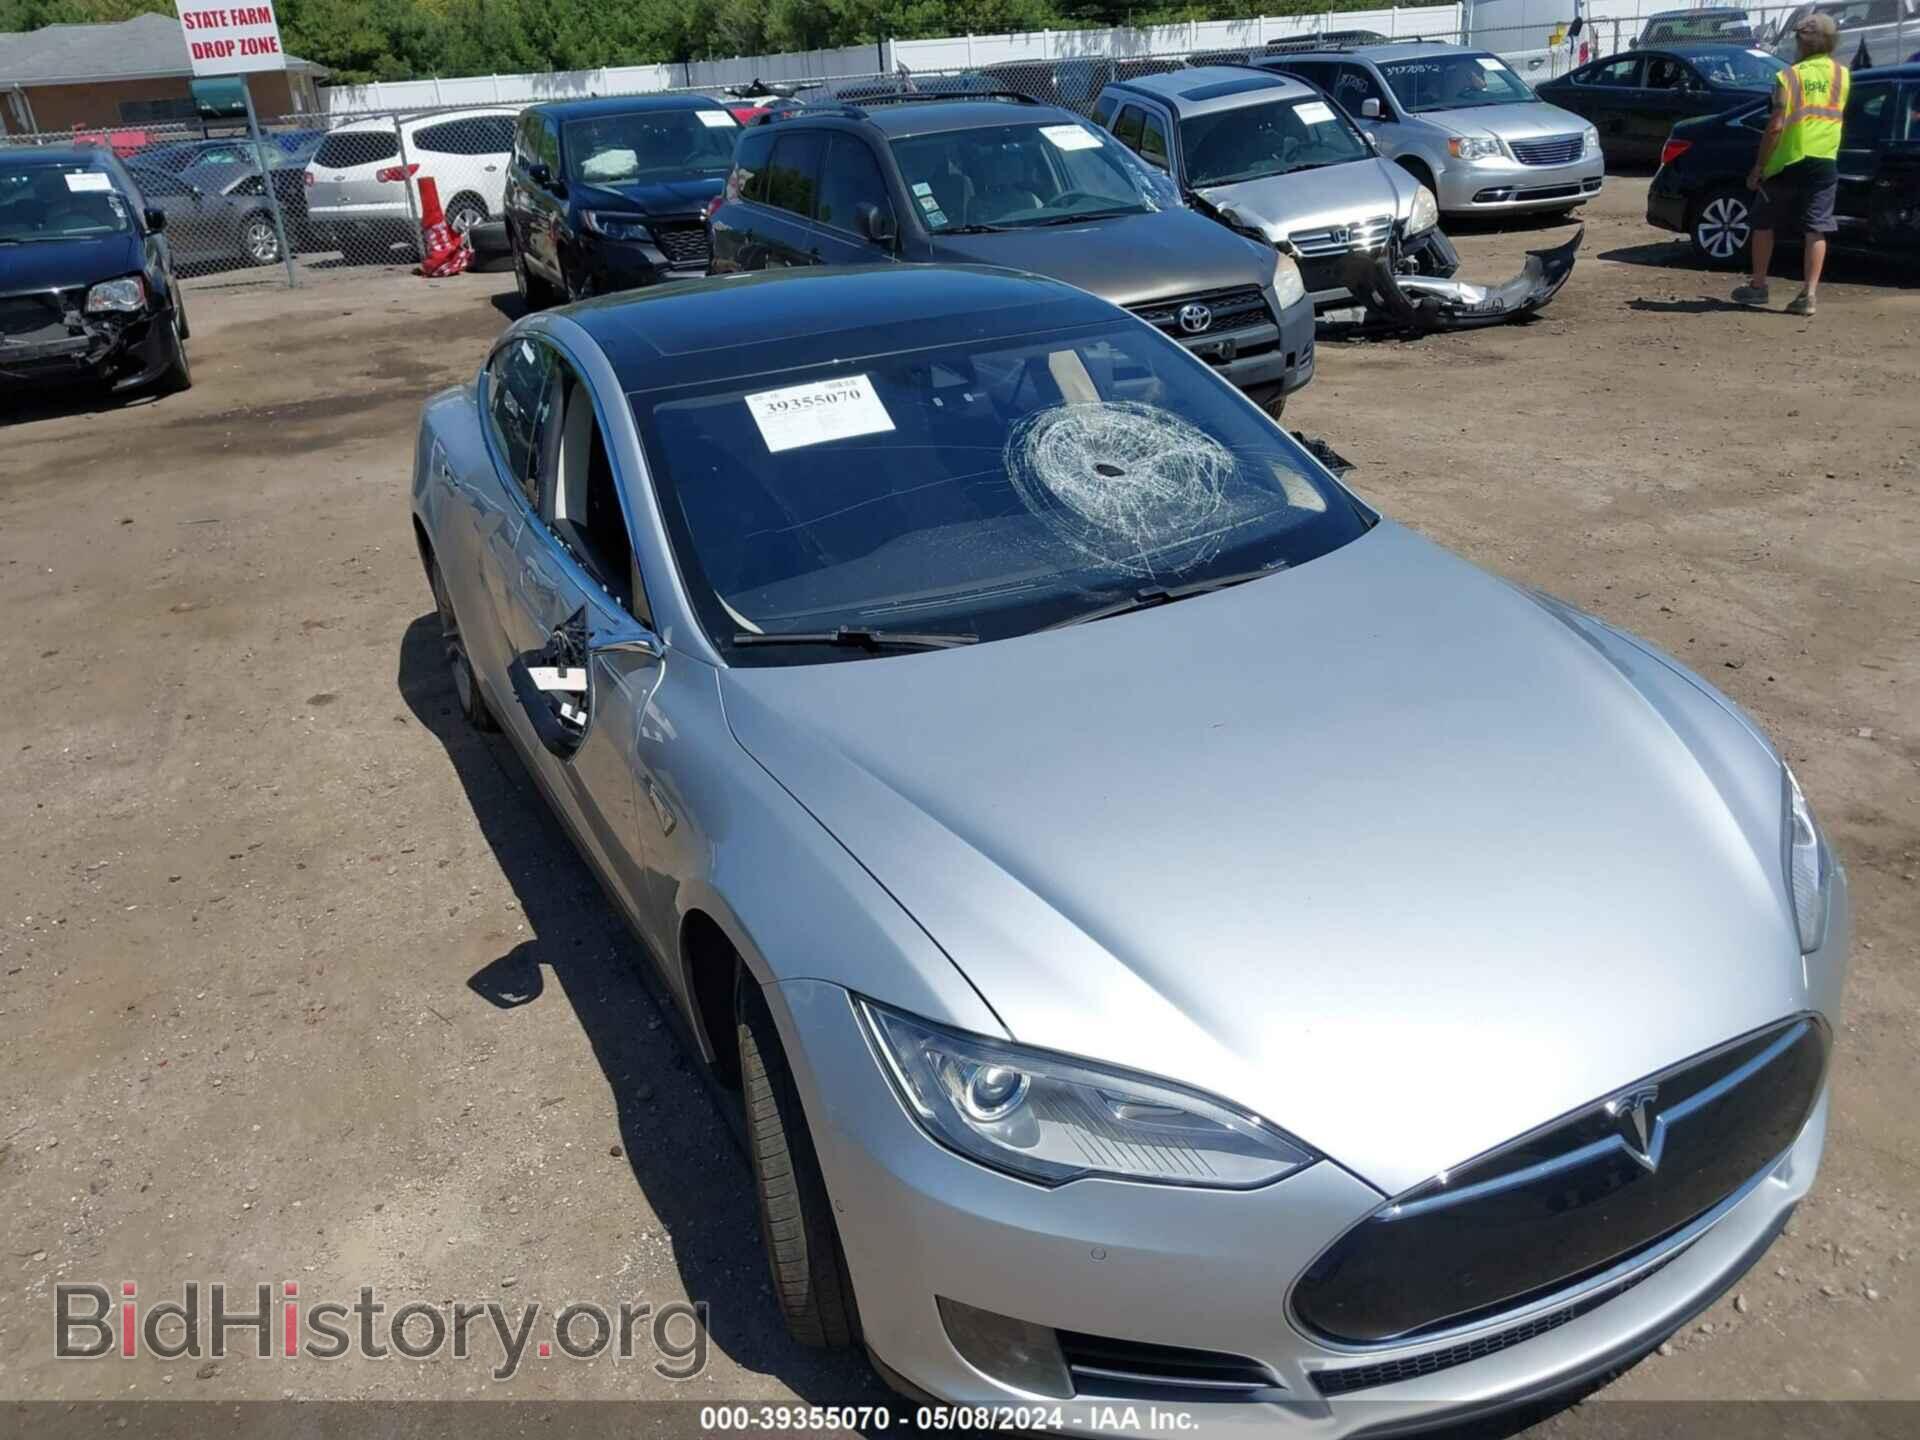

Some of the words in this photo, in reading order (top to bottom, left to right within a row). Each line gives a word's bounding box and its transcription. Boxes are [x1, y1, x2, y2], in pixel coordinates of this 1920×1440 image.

[183, 10, 229, 30] STATE
[230, 6, 272, 26] FARM
[191, 40, 235, 60] DROP
[238, 36, 279, 56] ZONE
[766, 389, 861, 413] 39355070
